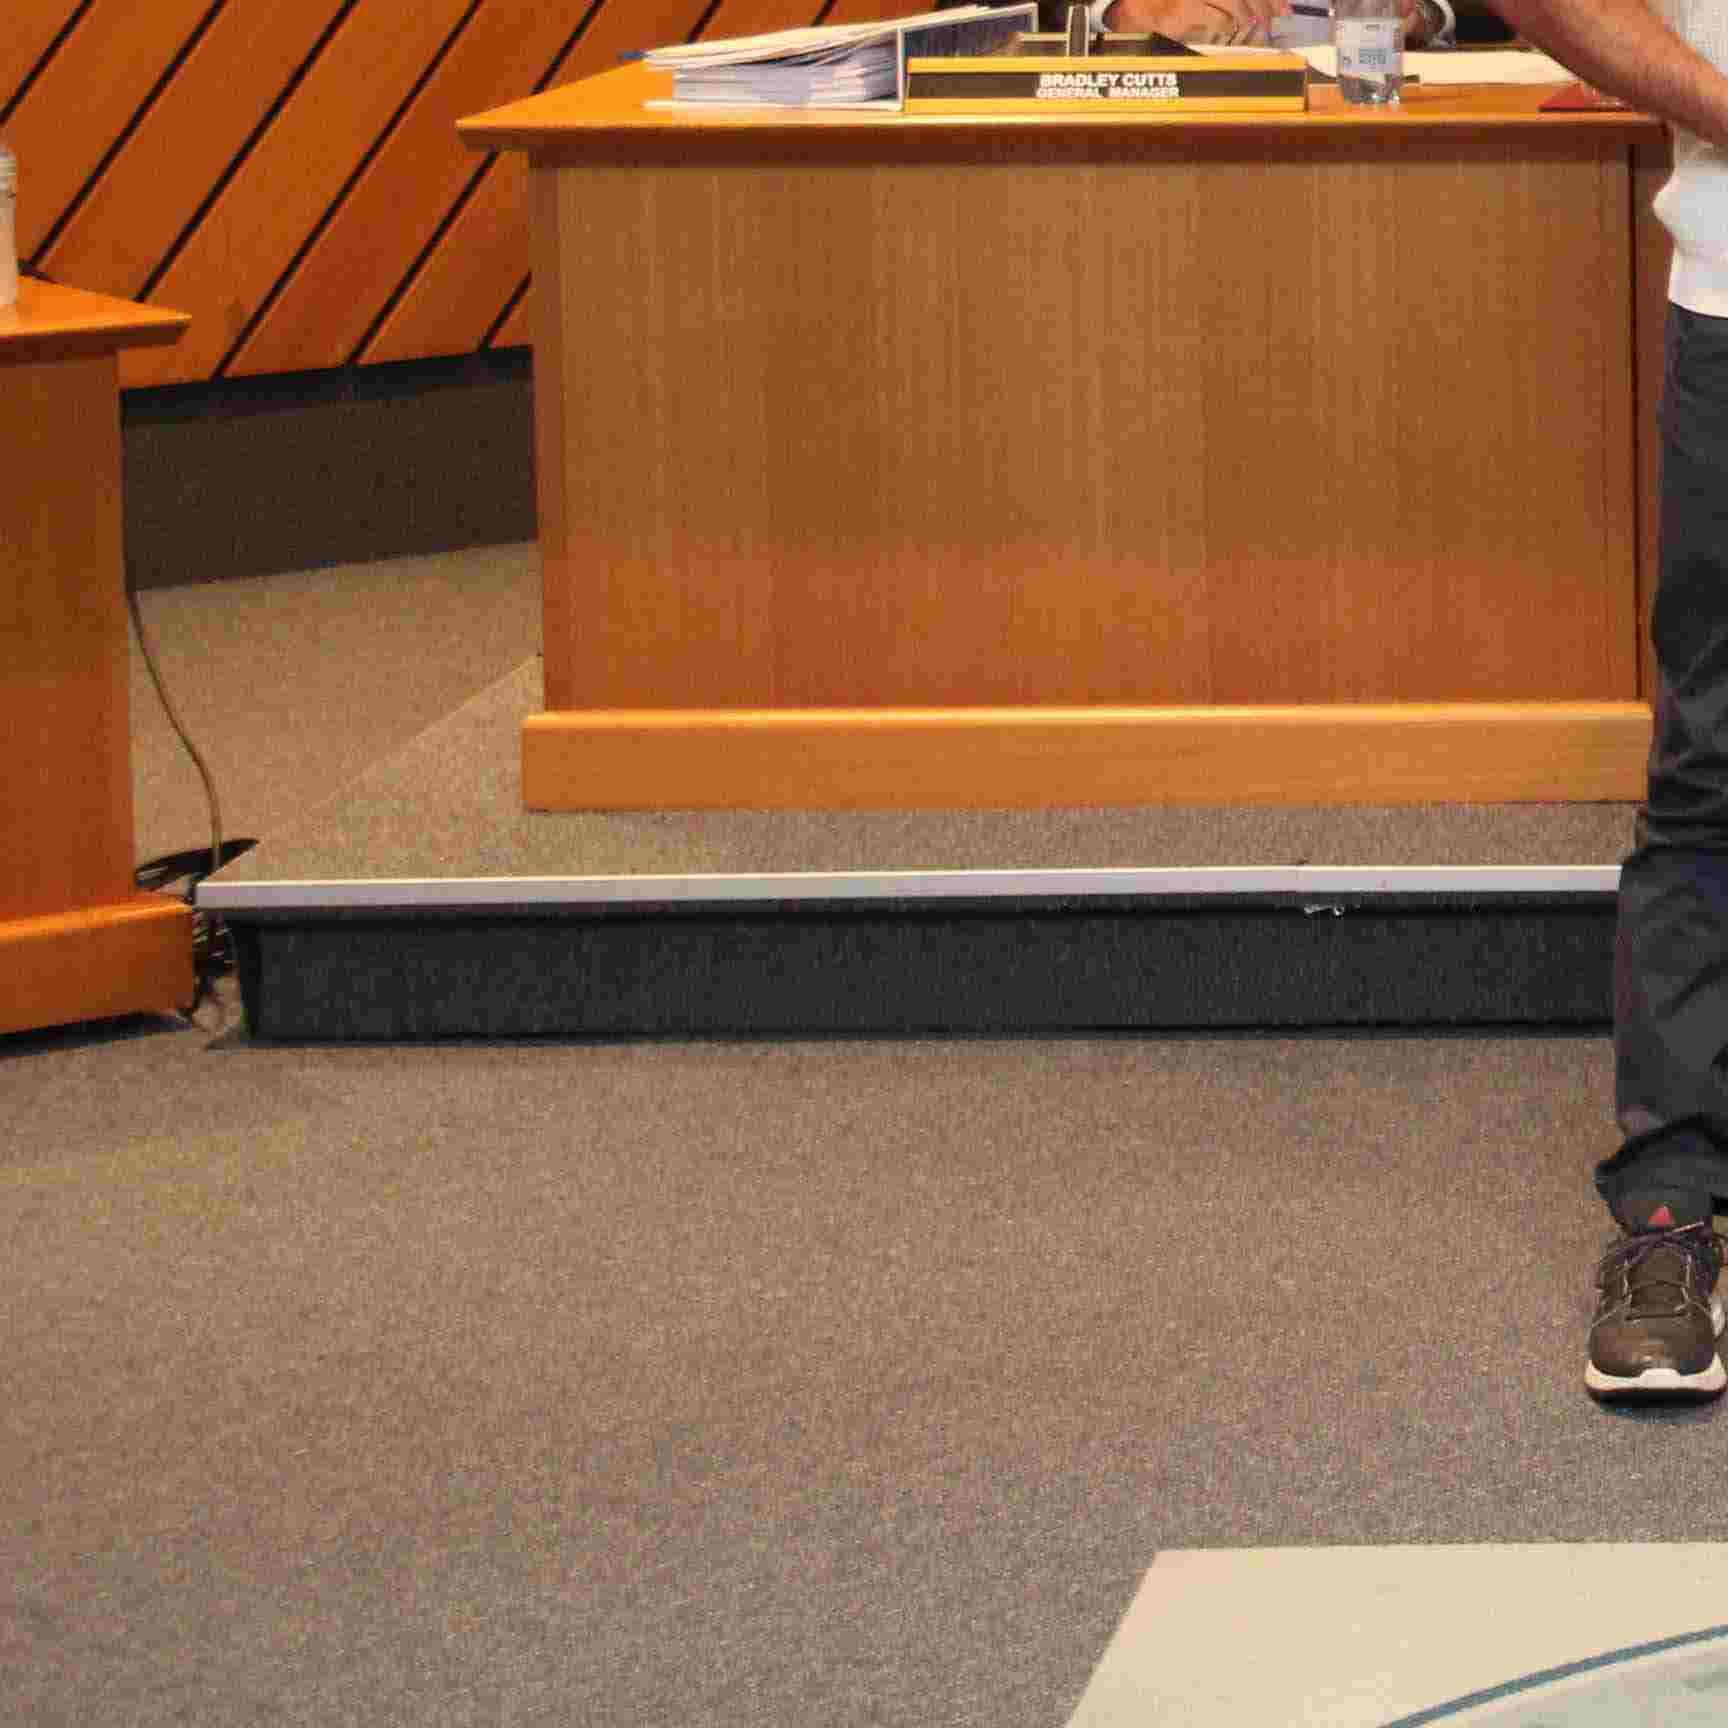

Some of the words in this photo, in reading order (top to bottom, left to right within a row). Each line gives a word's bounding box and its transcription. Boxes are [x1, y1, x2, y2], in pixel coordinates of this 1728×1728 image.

[1040, 73, 1119, 87] BRADLEY
[1122, 73, 1177, 87] CUTTS
[1036, 87, 1104, 98] GENERAL
[1108, 87, 1180, 98] MANAGER
